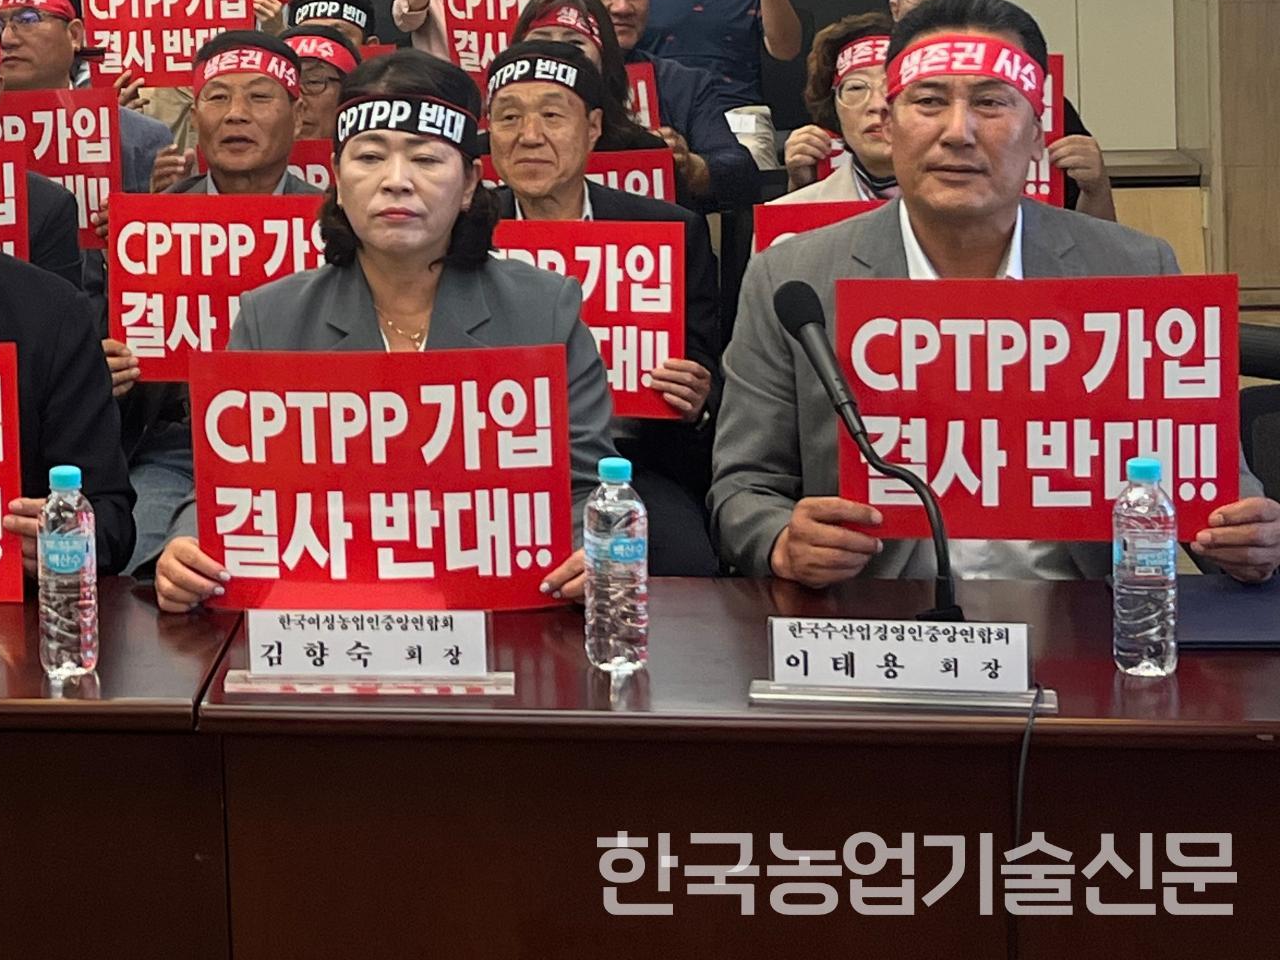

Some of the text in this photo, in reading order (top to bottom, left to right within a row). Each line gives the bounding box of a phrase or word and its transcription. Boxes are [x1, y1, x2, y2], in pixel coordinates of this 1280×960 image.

[295, 2, 367, 28] CPTPP 반대
[93, 29, 156, 74] 결사
[204, 49, 262, 80] 생존권
[267, 56, 298, 87] 사수
[296, 39, 334, 58] 사수
[534, 59, 577, 87] 반대
[900, 42, 1037, 91] 생존권 사수
[32, 107, 111, 164] 가입
[338, 101, 466, 143] CPTPP 반대
[117, 221, 256, 277] CPTPP
[574, 244, 672, 312] 가입
[121, 292, 217, 358] 결사
[851, 306, 1220, 400] CPTPP 가입
[592, 326, 669, 392] 대!!
[204, 377, 553, 471] CPTPP 가입
[860, 416, 1217, 508] 결사 반대!!
[215, 487, 552, 579] 결사 반대!!
